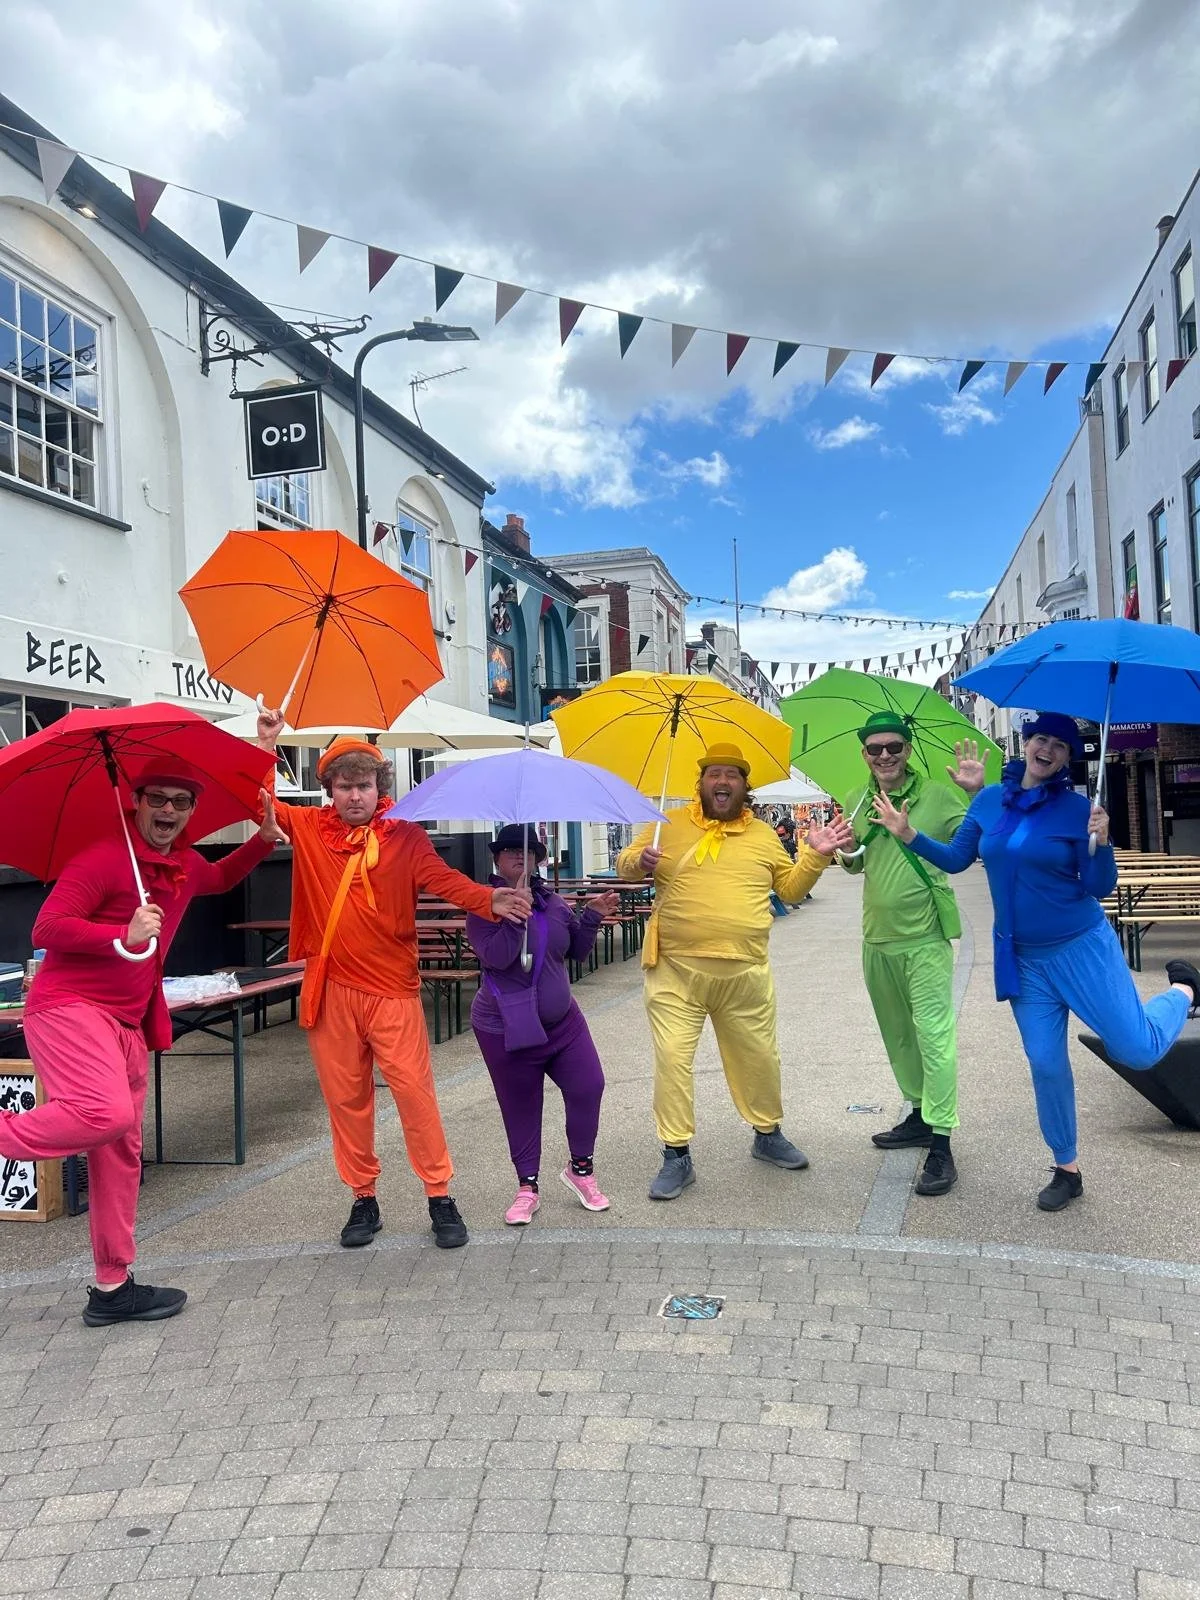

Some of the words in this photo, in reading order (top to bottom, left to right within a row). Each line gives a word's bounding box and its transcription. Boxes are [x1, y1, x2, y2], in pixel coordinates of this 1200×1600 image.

[262, 423, 306, 446] O:D
[27, 631, 105, 684] BEER
[172, 662, 234, 704] TACOS
[1110, 723, 1151, 731] MAMACITA'S
